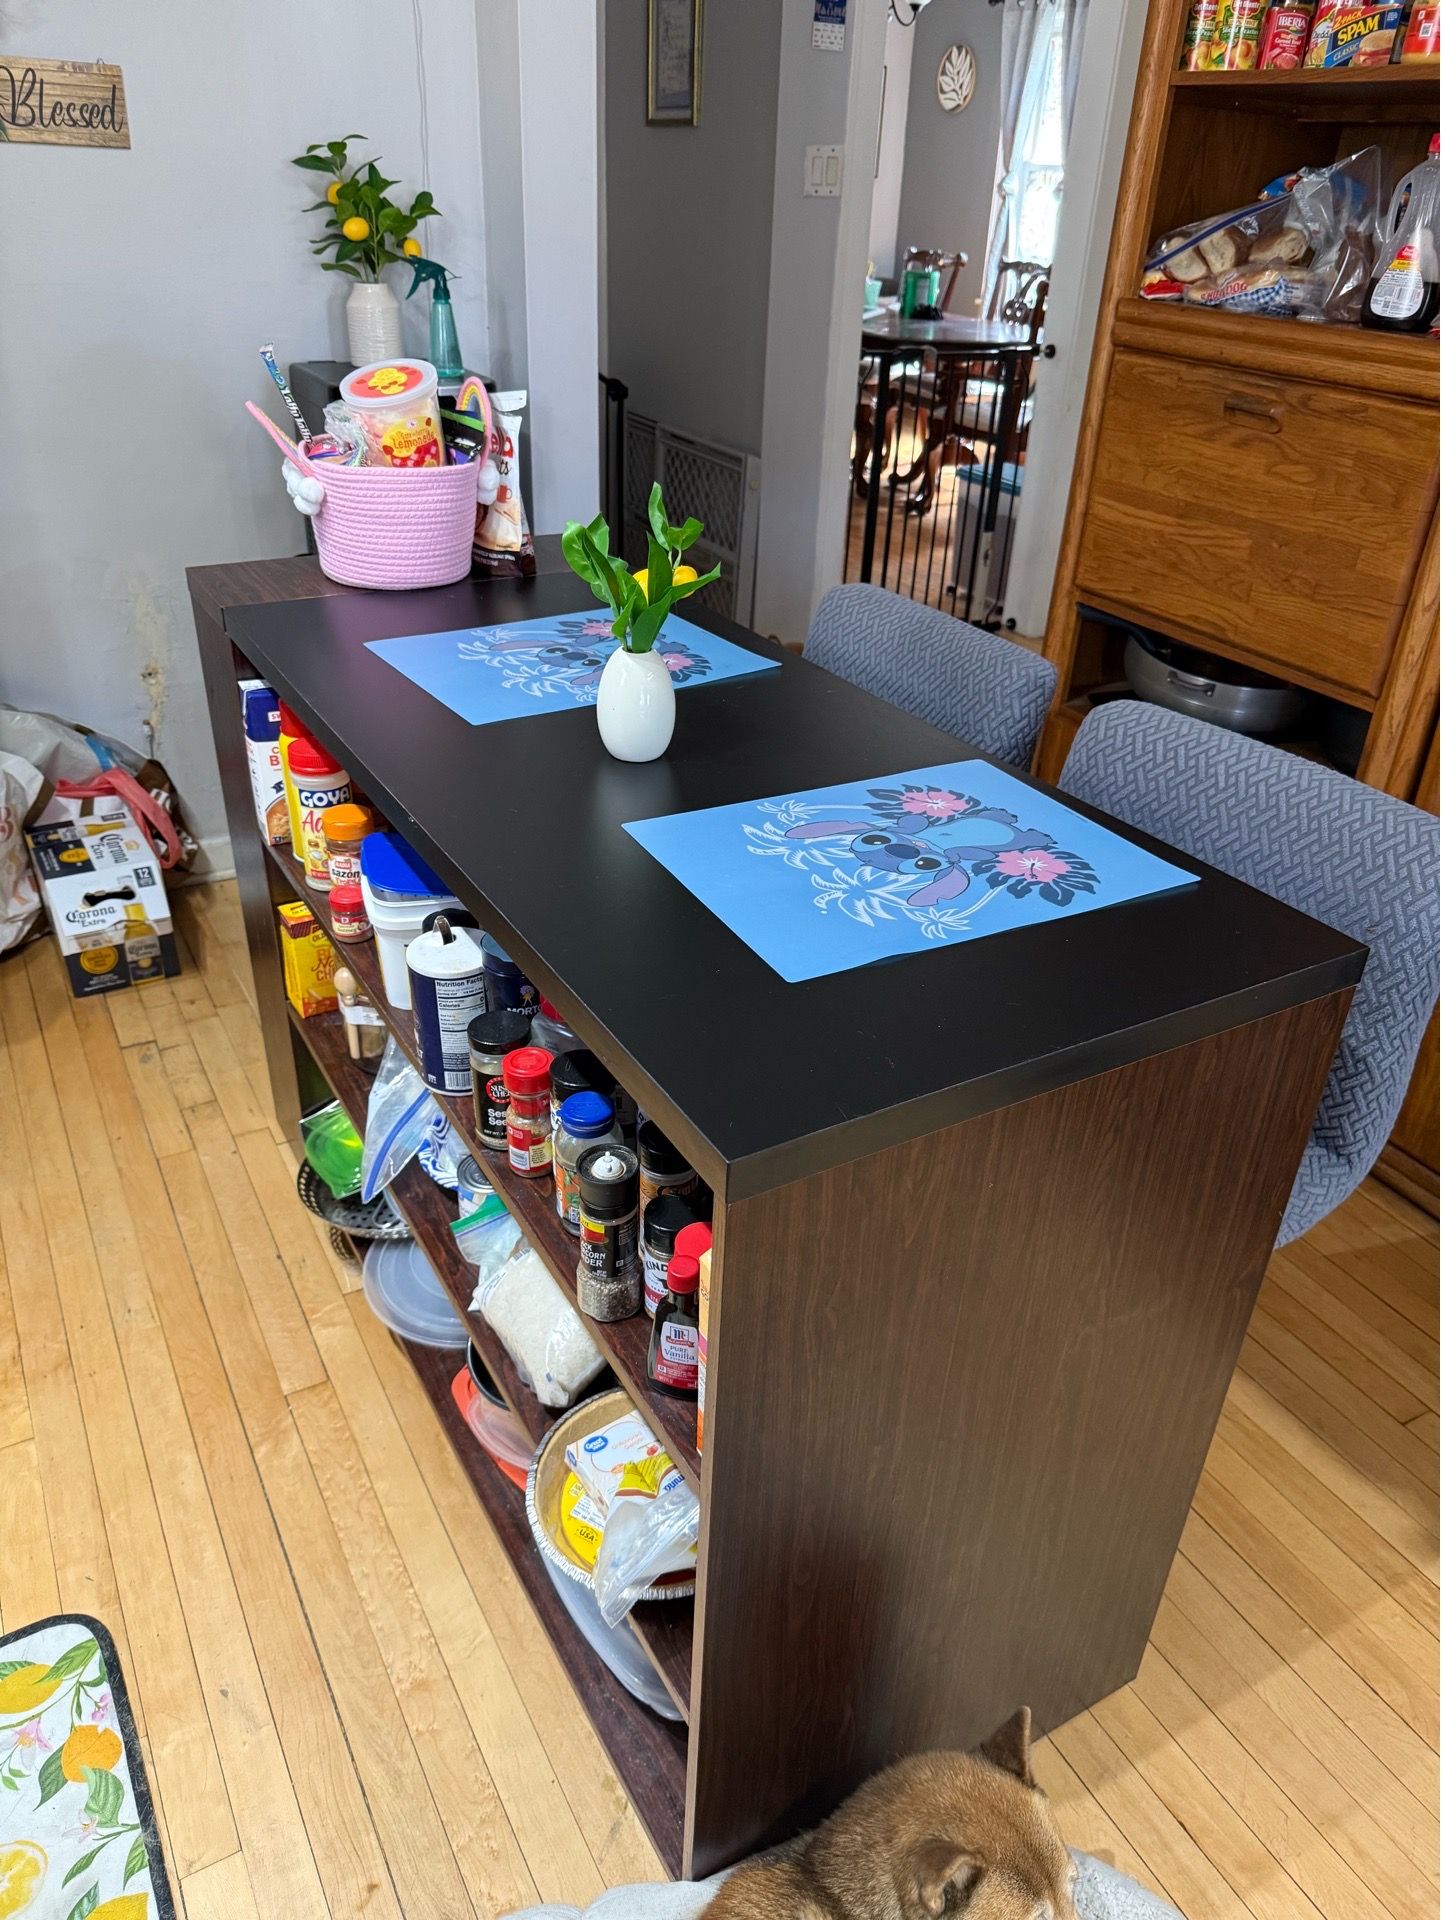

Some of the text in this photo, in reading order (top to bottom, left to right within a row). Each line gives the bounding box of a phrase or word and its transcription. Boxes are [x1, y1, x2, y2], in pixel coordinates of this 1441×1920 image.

[1278, 16, 1306, 28] IBERIA
[1338, 14, 1380, 45] SPAM
[0, 64, 123, 133] Blessed
[392, 430, 435, 449] Lemonade
[301, 786, 350, 807] GOYA
[137, 868, 150, 879] 12
[66, 906, 117, 923] Corona
[81, 918, 107, 928] Extra
[437, 976, 484, 988] Nutrition Facts
[507, 1005, 541, 1016] MORT
[488, 1108, 507, 1118] Ses
[488, 1117, 508, 1126] See
[646, 1261, 668, 1272] KIND
[664, 1348, 695, 1361] Vanilla
[670, 1345, 688, 1354] PURE
[579, 1528, 596, 1542] USA
